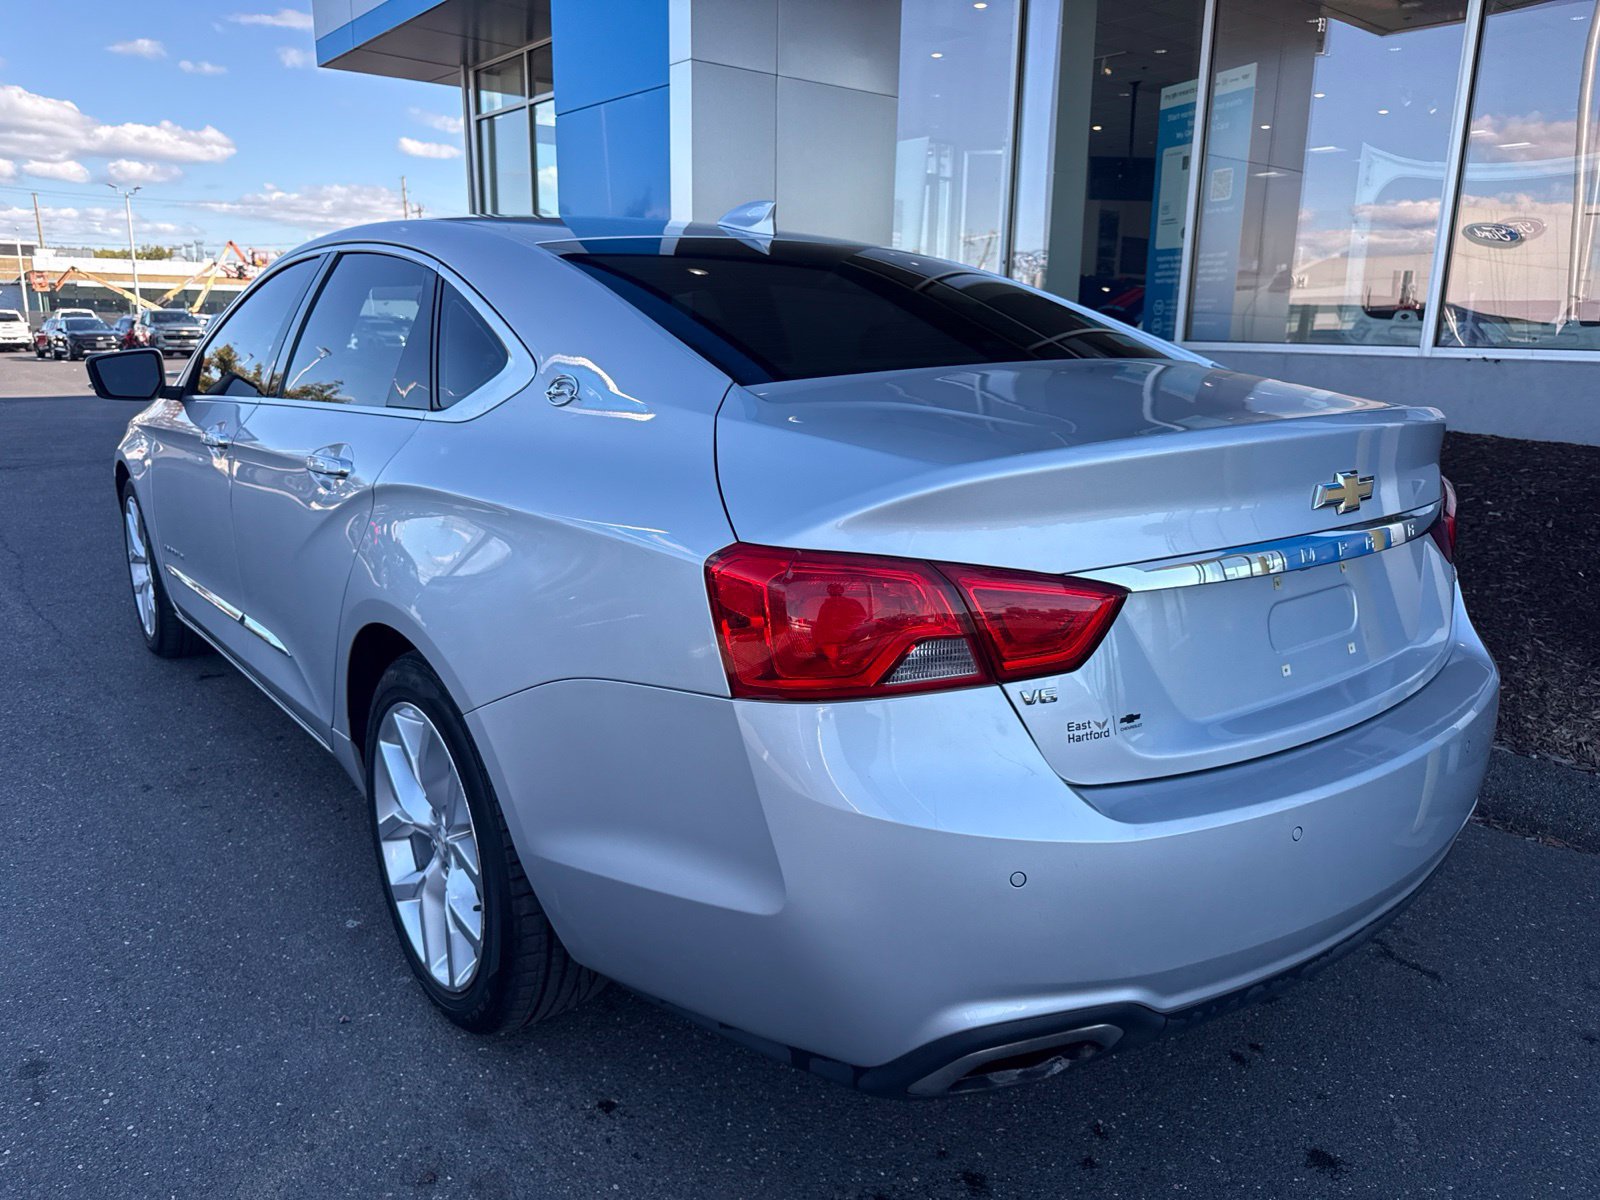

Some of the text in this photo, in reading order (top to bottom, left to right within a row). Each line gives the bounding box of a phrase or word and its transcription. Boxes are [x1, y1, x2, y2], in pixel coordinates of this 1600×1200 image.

[1019, 687, 1058, 706] V6
[1067, 720, 1092, 732] East
[1067, 727, 1110, 743] Hartford
